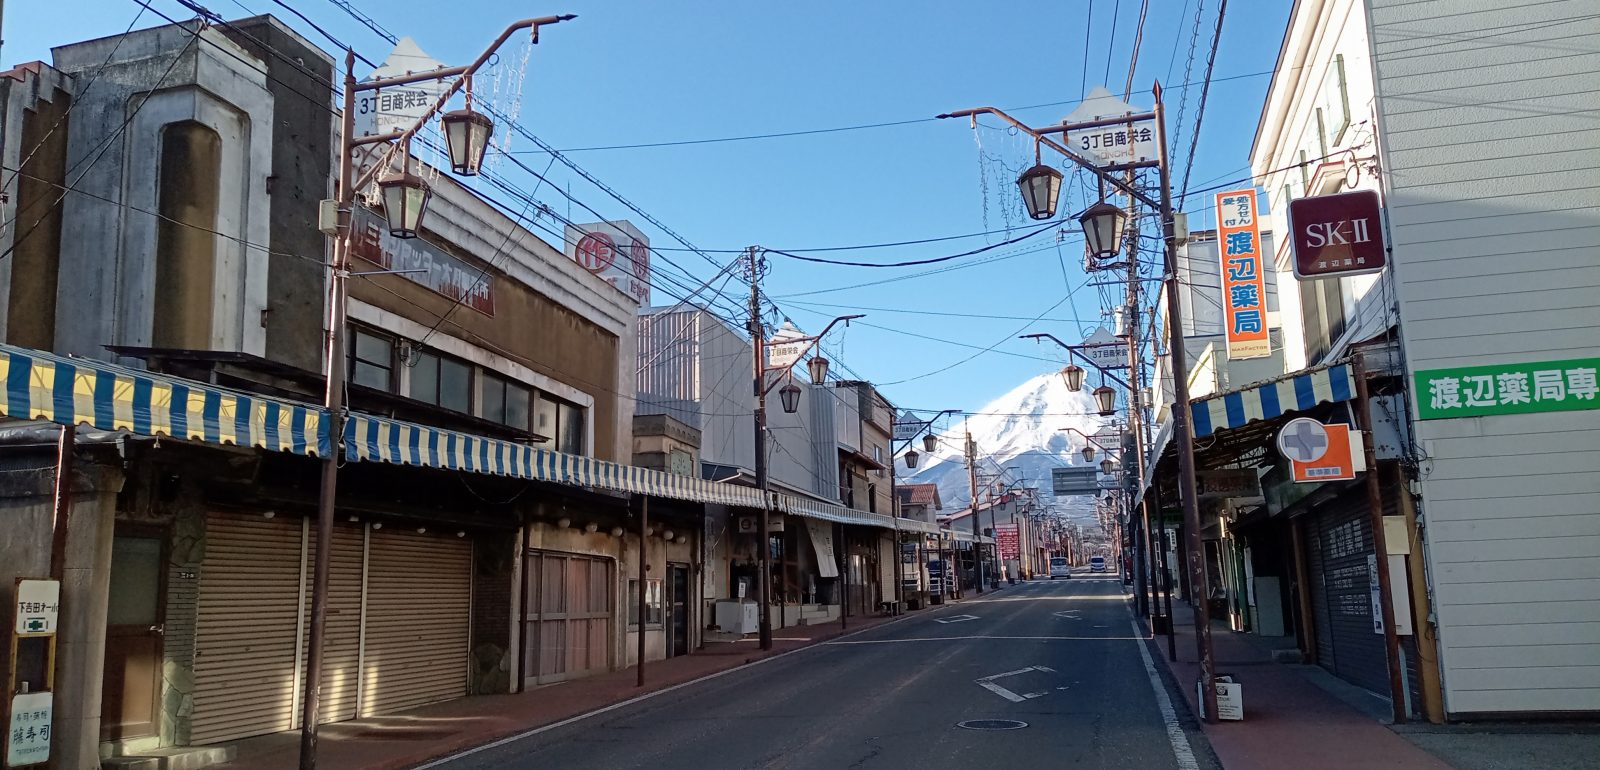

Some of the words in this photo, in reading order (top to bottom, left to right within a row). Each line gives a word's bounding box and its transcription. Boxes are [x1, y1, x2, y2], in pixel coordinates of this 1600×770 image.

[360, 90, 428, 114] 3丁目商栄会
[1081, 127, 1152, 150] 3丁目商栄会
[1236, 196, 1251, 225] 処方せん
[1306, 217, 1372, 248] SK-II
[1226, 231, 1263, 335] 渡辺薬局
[1428, 367, 1600, 410] 渡辺薬局専
